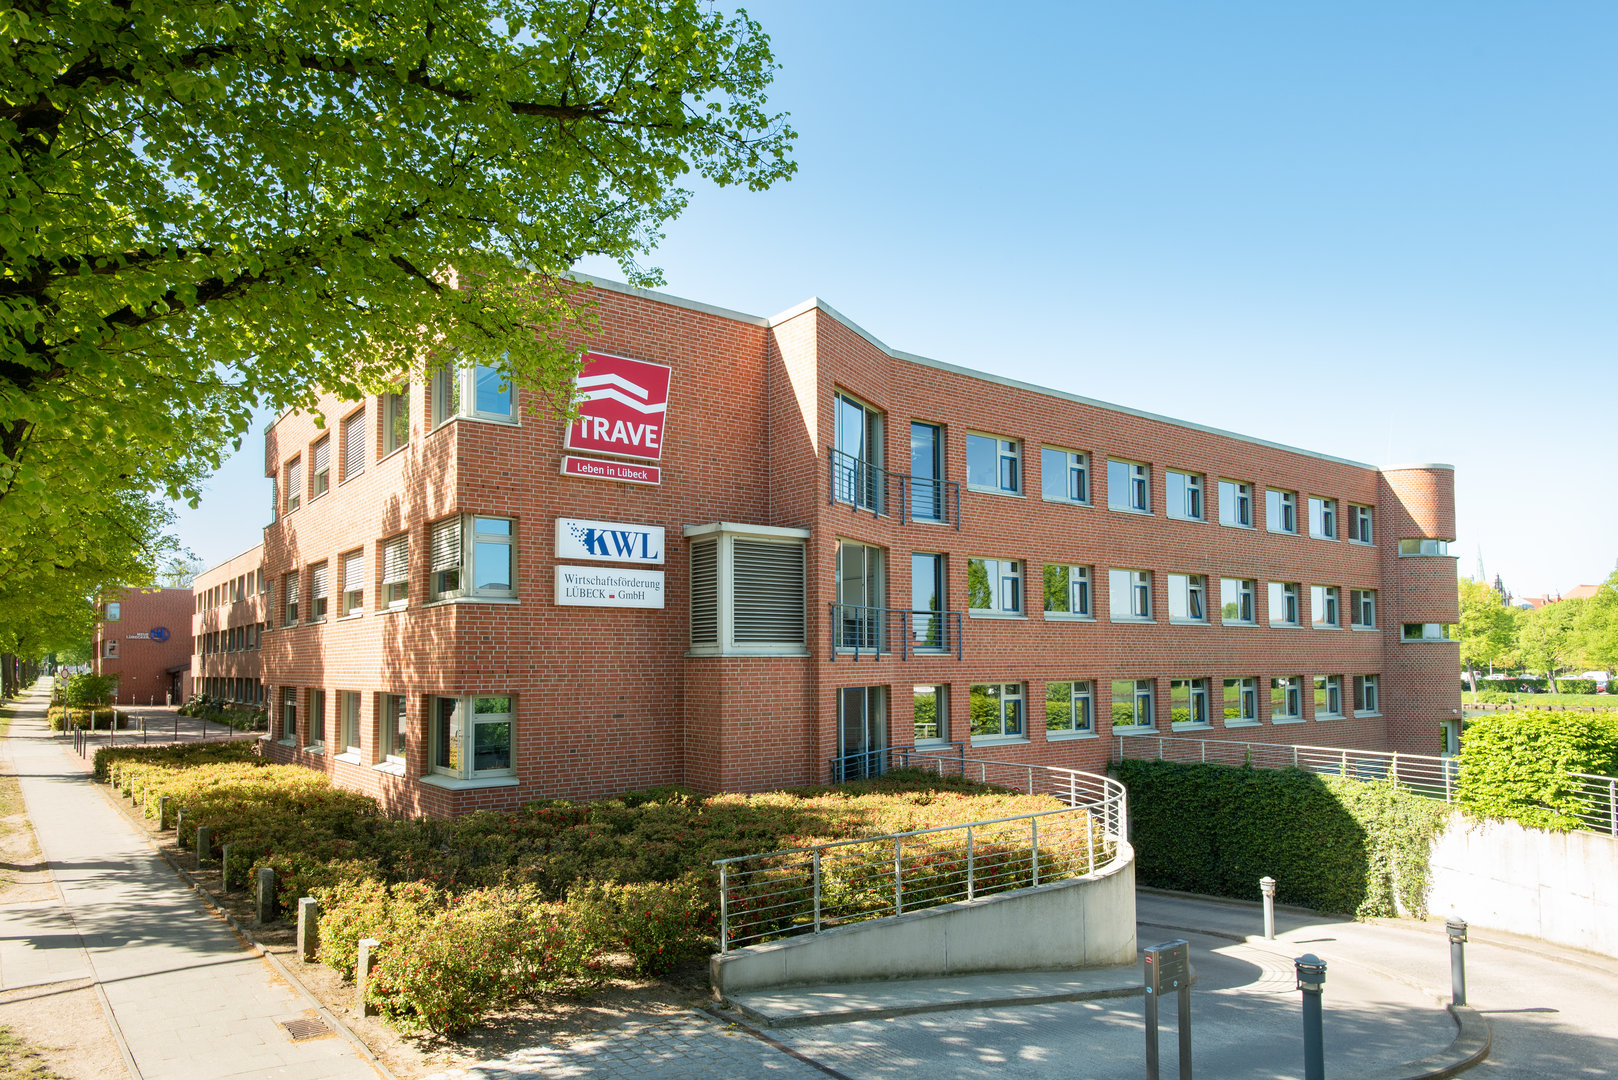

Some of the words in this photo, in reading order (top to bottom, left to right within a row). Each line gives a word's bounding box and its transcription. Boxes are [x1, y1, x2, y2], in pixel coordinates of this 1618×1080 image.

[580, 415, 659, 449] TRAVE
[577, 463, 604, 475] Leben
[606, 466, 615, 476] in
[617, 467, 648, 480] Lübeck
[583, 528, 658, 560] KWL
[564, 573, 661, 591] Wirtschaftsförderung
[566, 586, 606, 599] LÜBECK
[618, 590, 645, 600] GmbH
